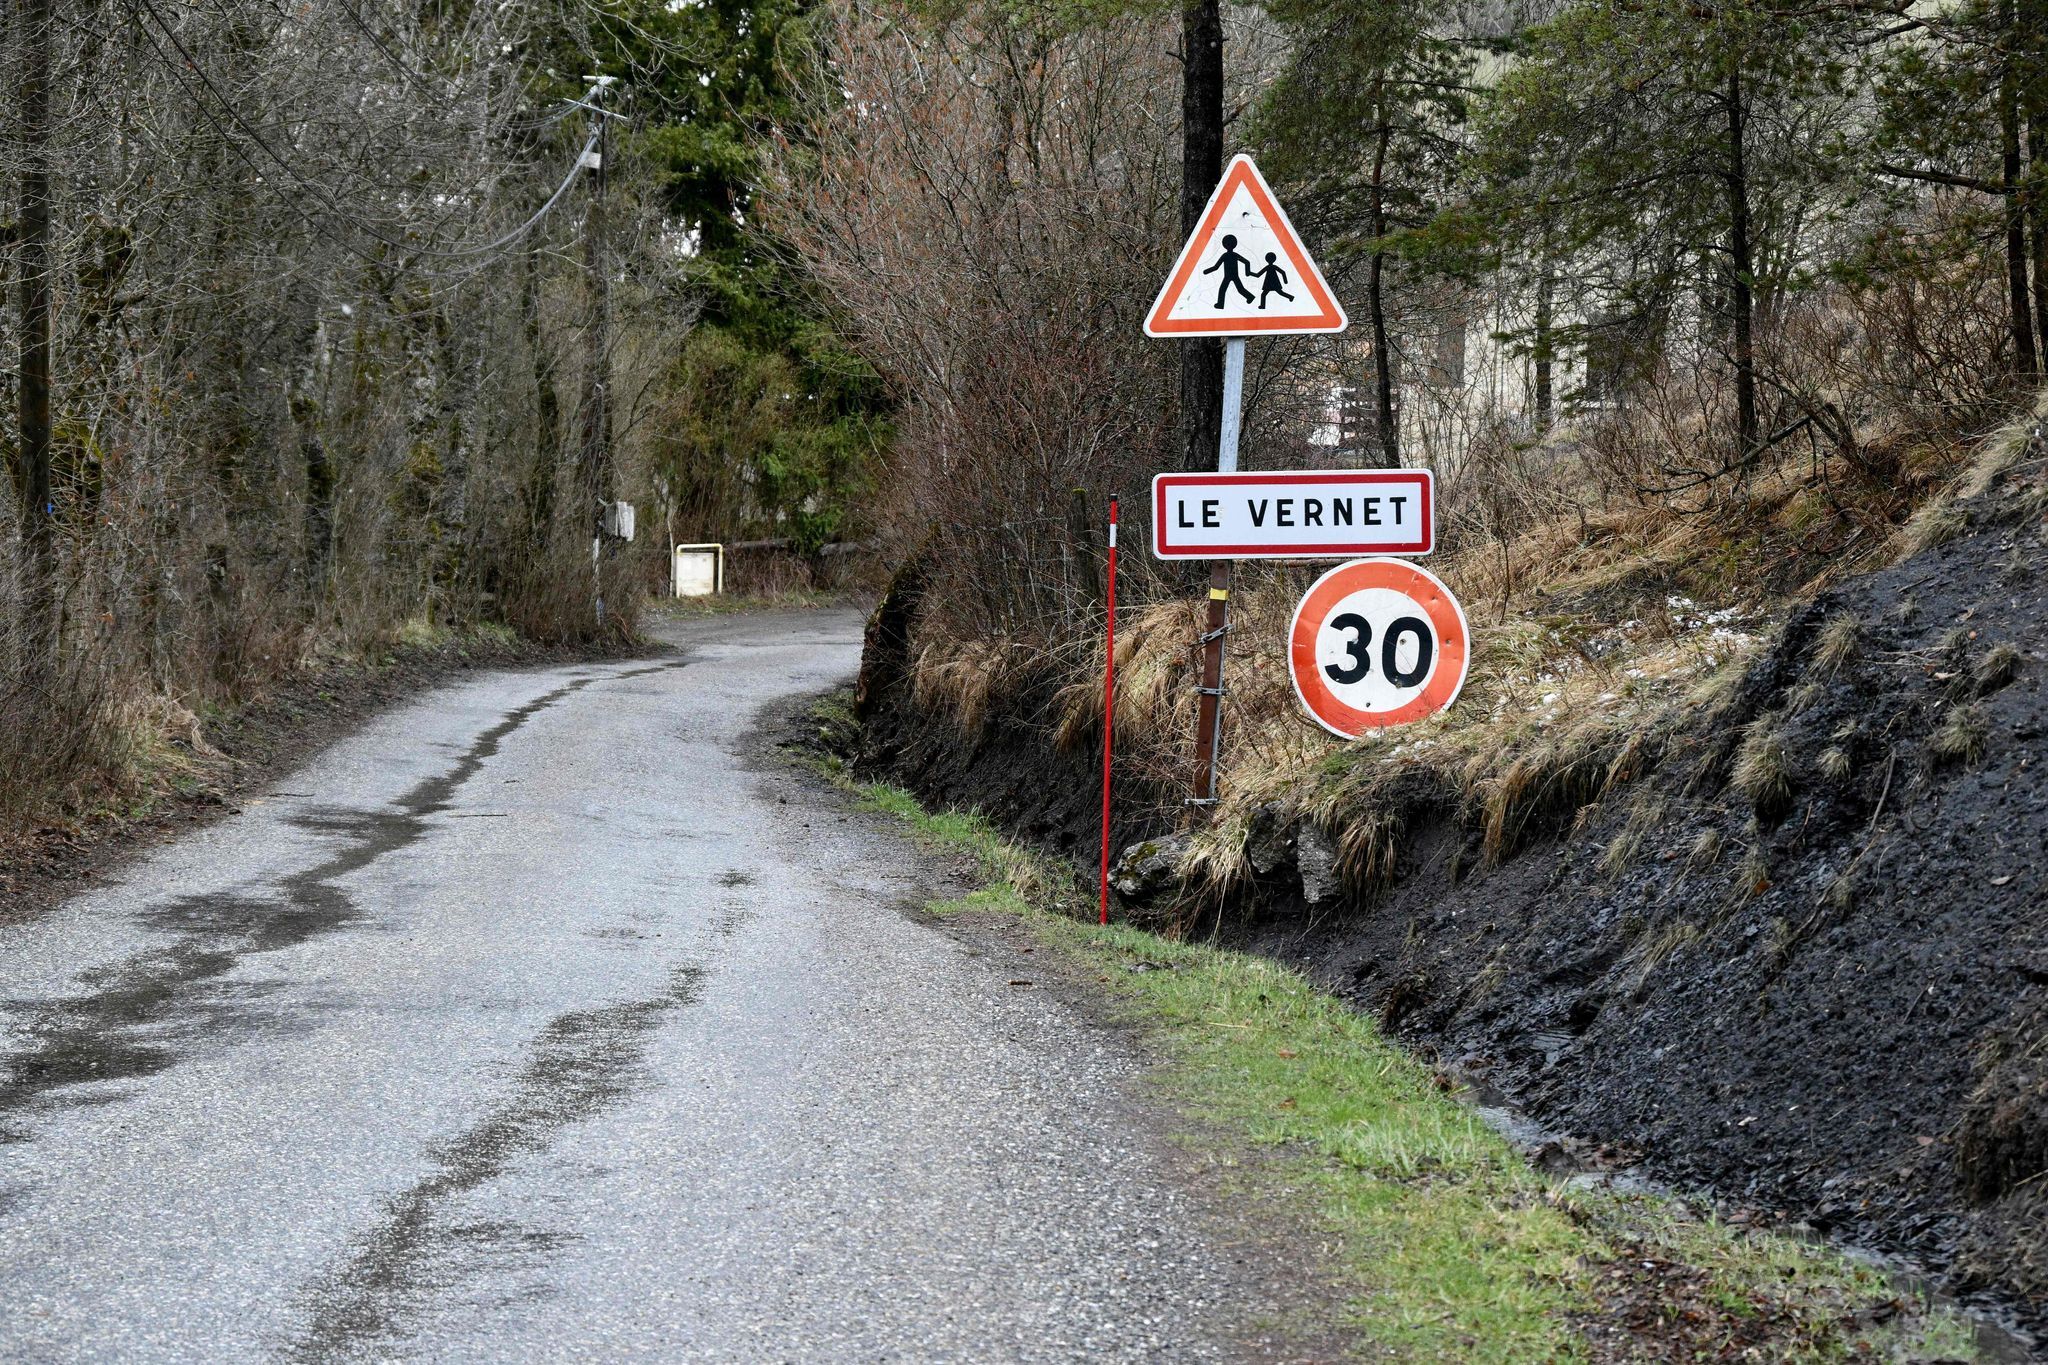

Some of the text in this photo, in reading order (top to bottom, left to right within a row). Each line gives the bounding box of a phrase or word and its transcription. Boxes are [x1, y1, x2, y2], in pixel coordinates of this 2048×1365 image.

[1178, 496, 1407, 528] LE VERNET
[1324, 613, 1433, 688] 30
